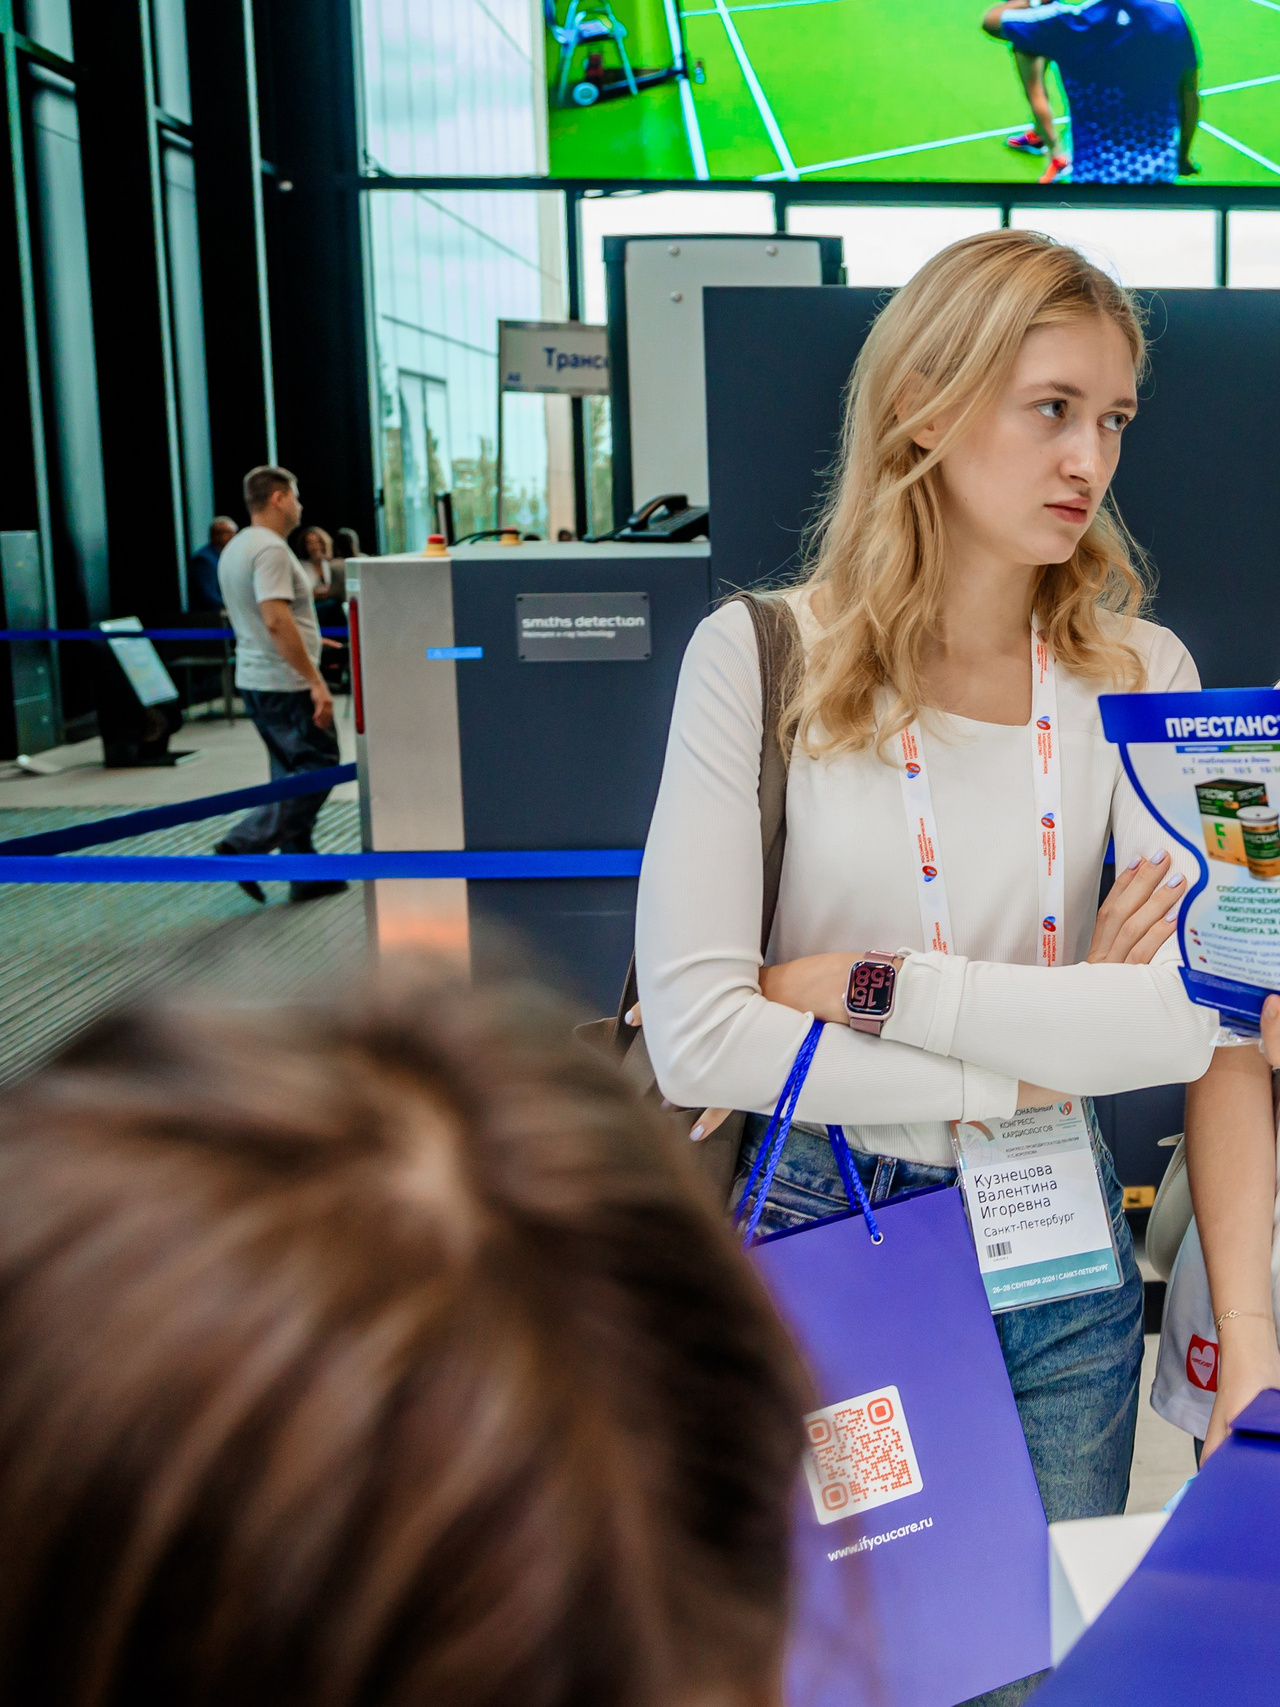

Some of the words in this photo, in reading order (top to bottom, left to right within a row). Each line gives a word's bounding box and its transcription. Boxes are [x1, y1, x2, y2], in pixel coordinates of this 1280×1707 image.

[544, 347, 609, 372] Транс
[522, 617, 572, 628] smiths
[575, 616, 645, 628] detection
[1015, 1104, 1054, 1116] ОНАЛЬНЫЙ
[1000, 1118, 1036, 1128] КОНГРЕСС
[1002, 1125, 1054, 1139] КАРДИОЛОГОВ
[974, 1164, 1053, 1190] Кузнецова
[978, 1180, 1058, 1204] Валентина
[980, 1196, 1051, 1220] Игоревна
[984, 1212, 1076, 1238] Санкт-Петербург
[1011, 1278, 1041, 1290] СЕНТЯБРЯ
[1042, 1276, 1056, 1284] 2024
[1058, 1264, 1108, 1280] САНКТ-ПЕТЕРБУРГ
[828, 1516, 934, 1562] www.ifyoucare.ru
